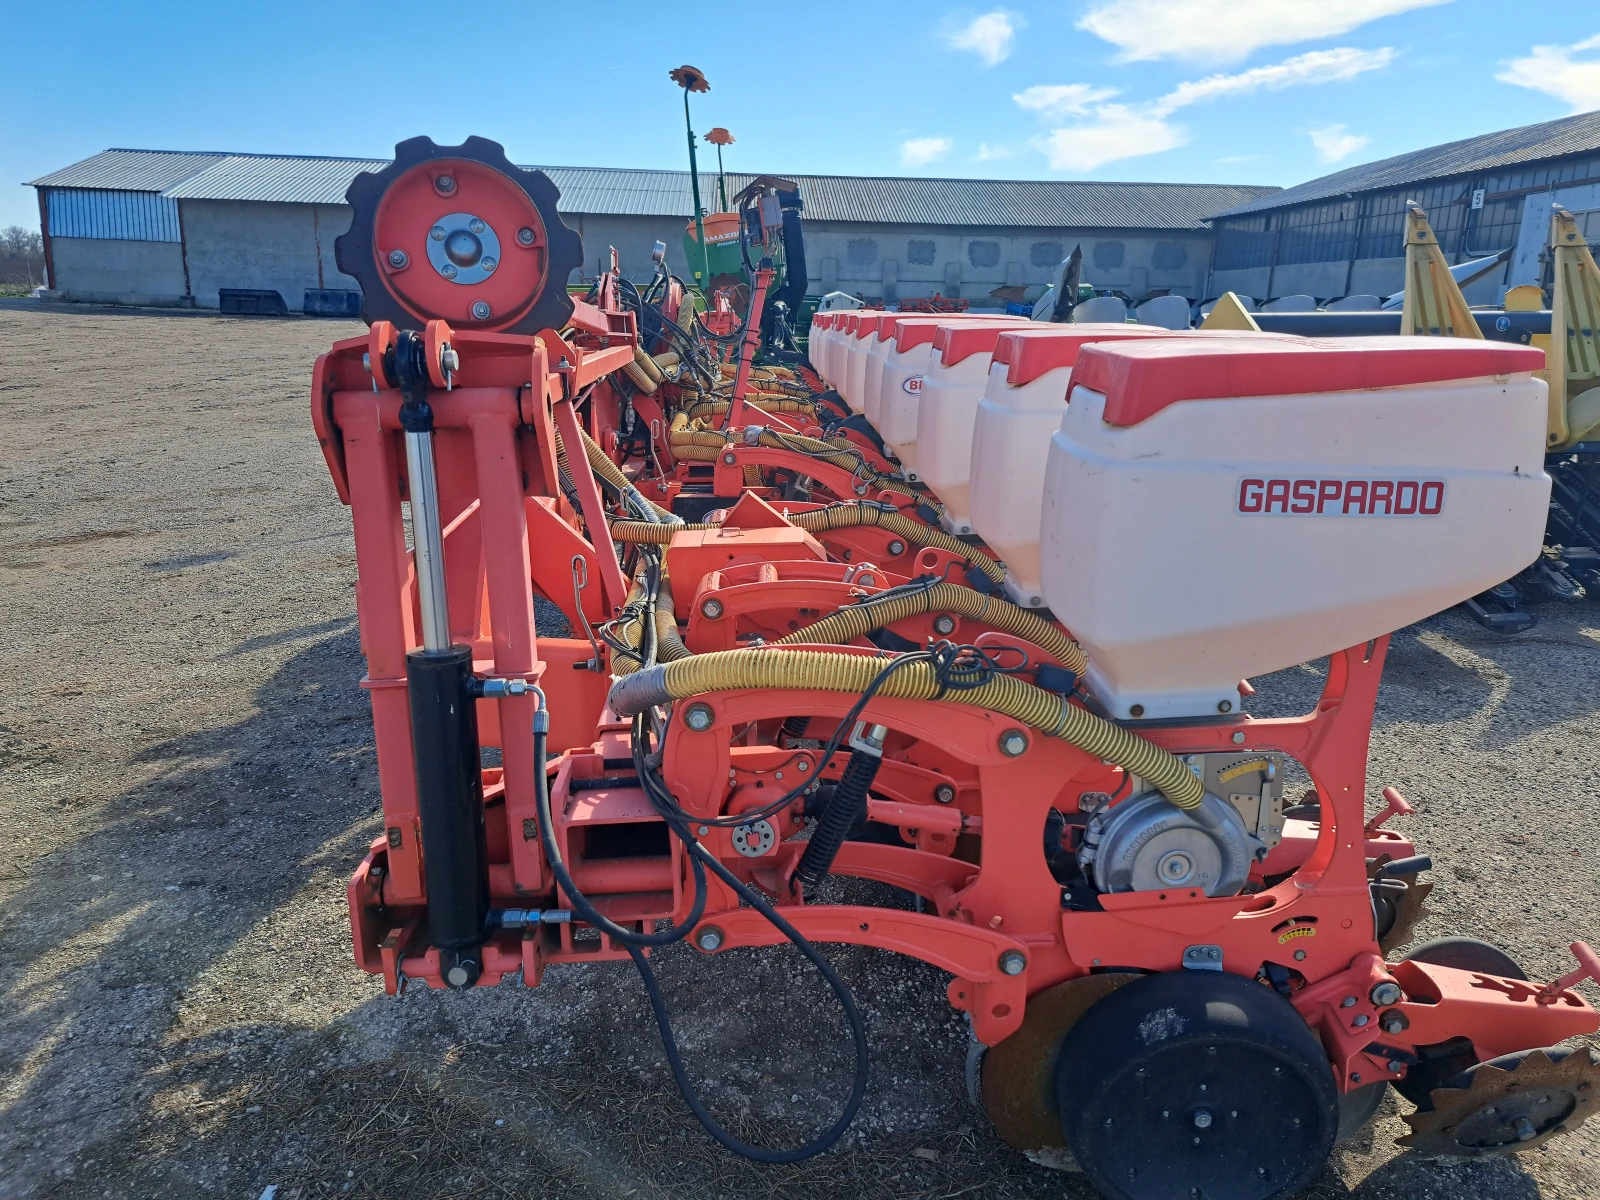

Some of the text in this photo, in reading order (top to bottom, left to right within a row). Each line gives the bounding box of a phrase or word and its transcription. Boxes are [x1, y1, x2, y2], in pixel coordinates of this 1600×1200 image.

[1475, 193, 1482, 205] 5
[704, 230, 748, 242] AMAZO
[1238, 478, 1445, 515] GASPARDO
